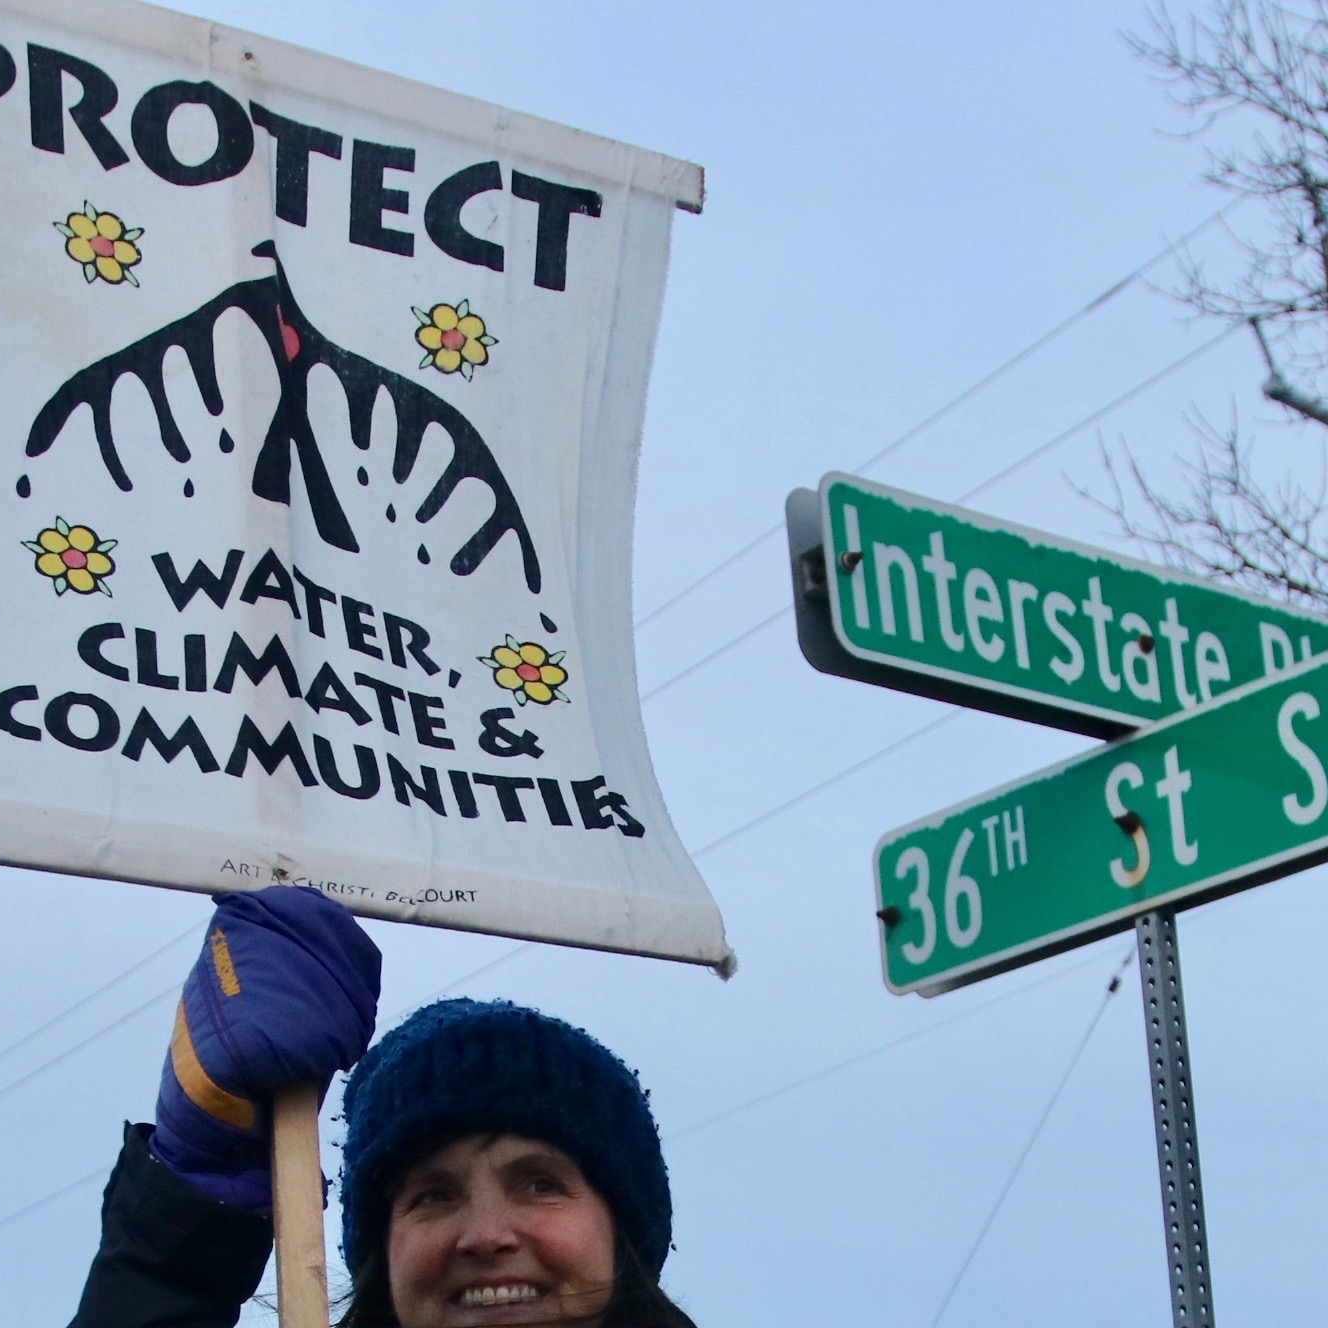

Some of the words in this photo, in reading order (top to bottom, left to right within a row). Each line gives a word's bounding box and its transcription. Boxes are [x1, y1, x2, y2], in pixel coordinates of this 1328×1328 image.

[152, 547, 462, 689] WATER,
[842, 502, 1232, 712] Interstate
[76, 622, 455, 752] CLIMATE
[477, 705, 545, 760] &
[220, 859, 263, 879] ART
[1104, 743, 1200, 890] St
